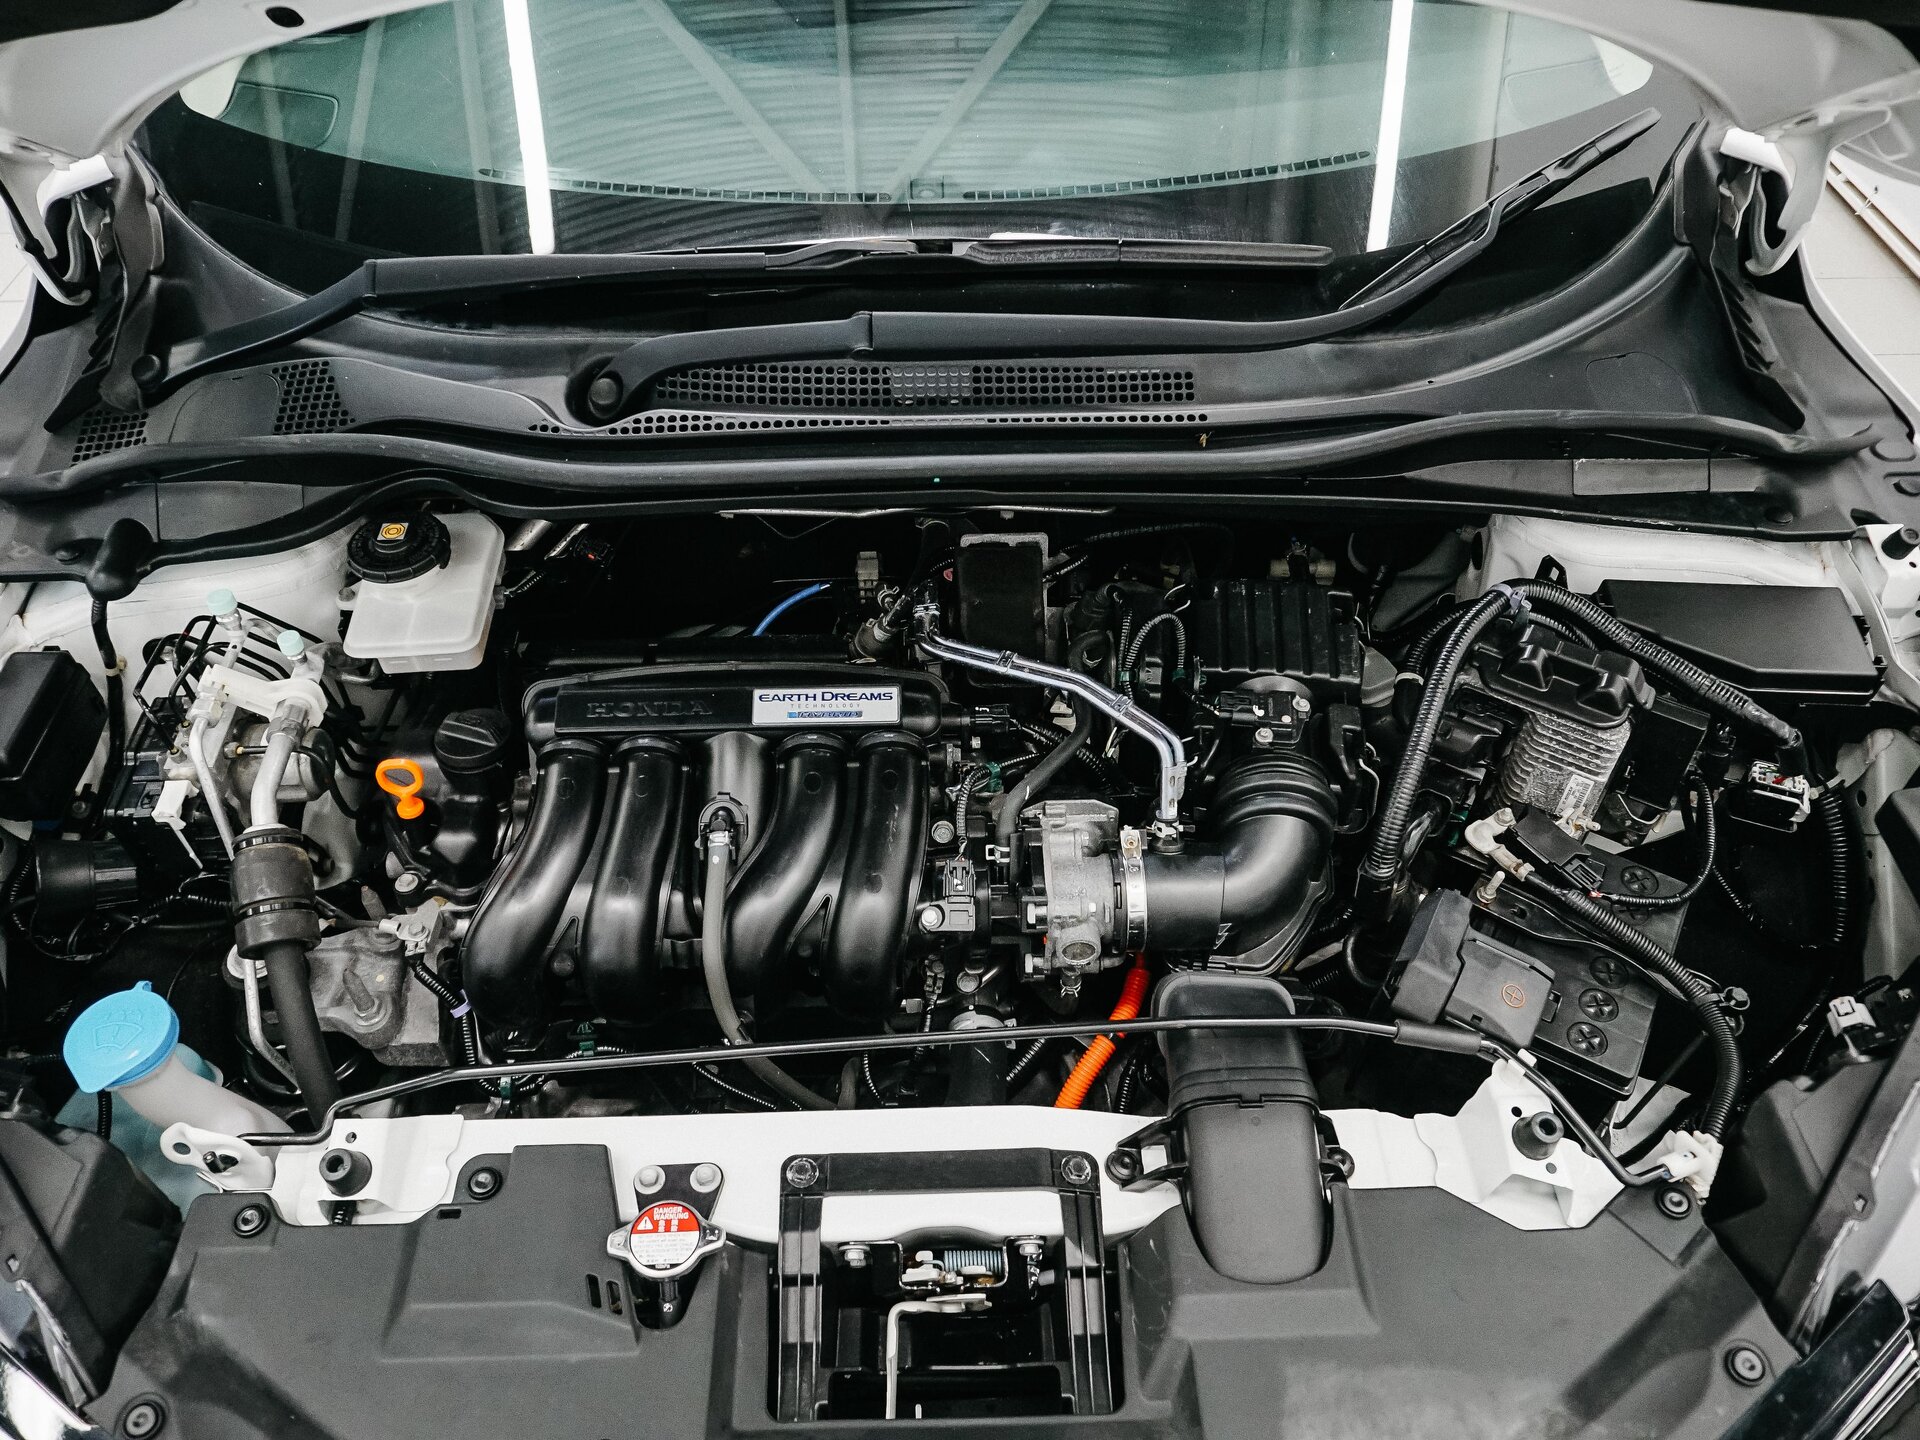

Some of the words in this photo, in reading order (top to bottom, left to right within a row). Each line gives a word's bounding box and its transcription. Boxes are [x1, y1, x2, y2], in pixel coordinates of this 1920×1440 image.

[758, 692, 817, 703] EARTH
[821, 691, 894, 702] DREAMS
[586, 700, 713, 718] HONDA
[653, 1206, 682, 1214] DANGER
